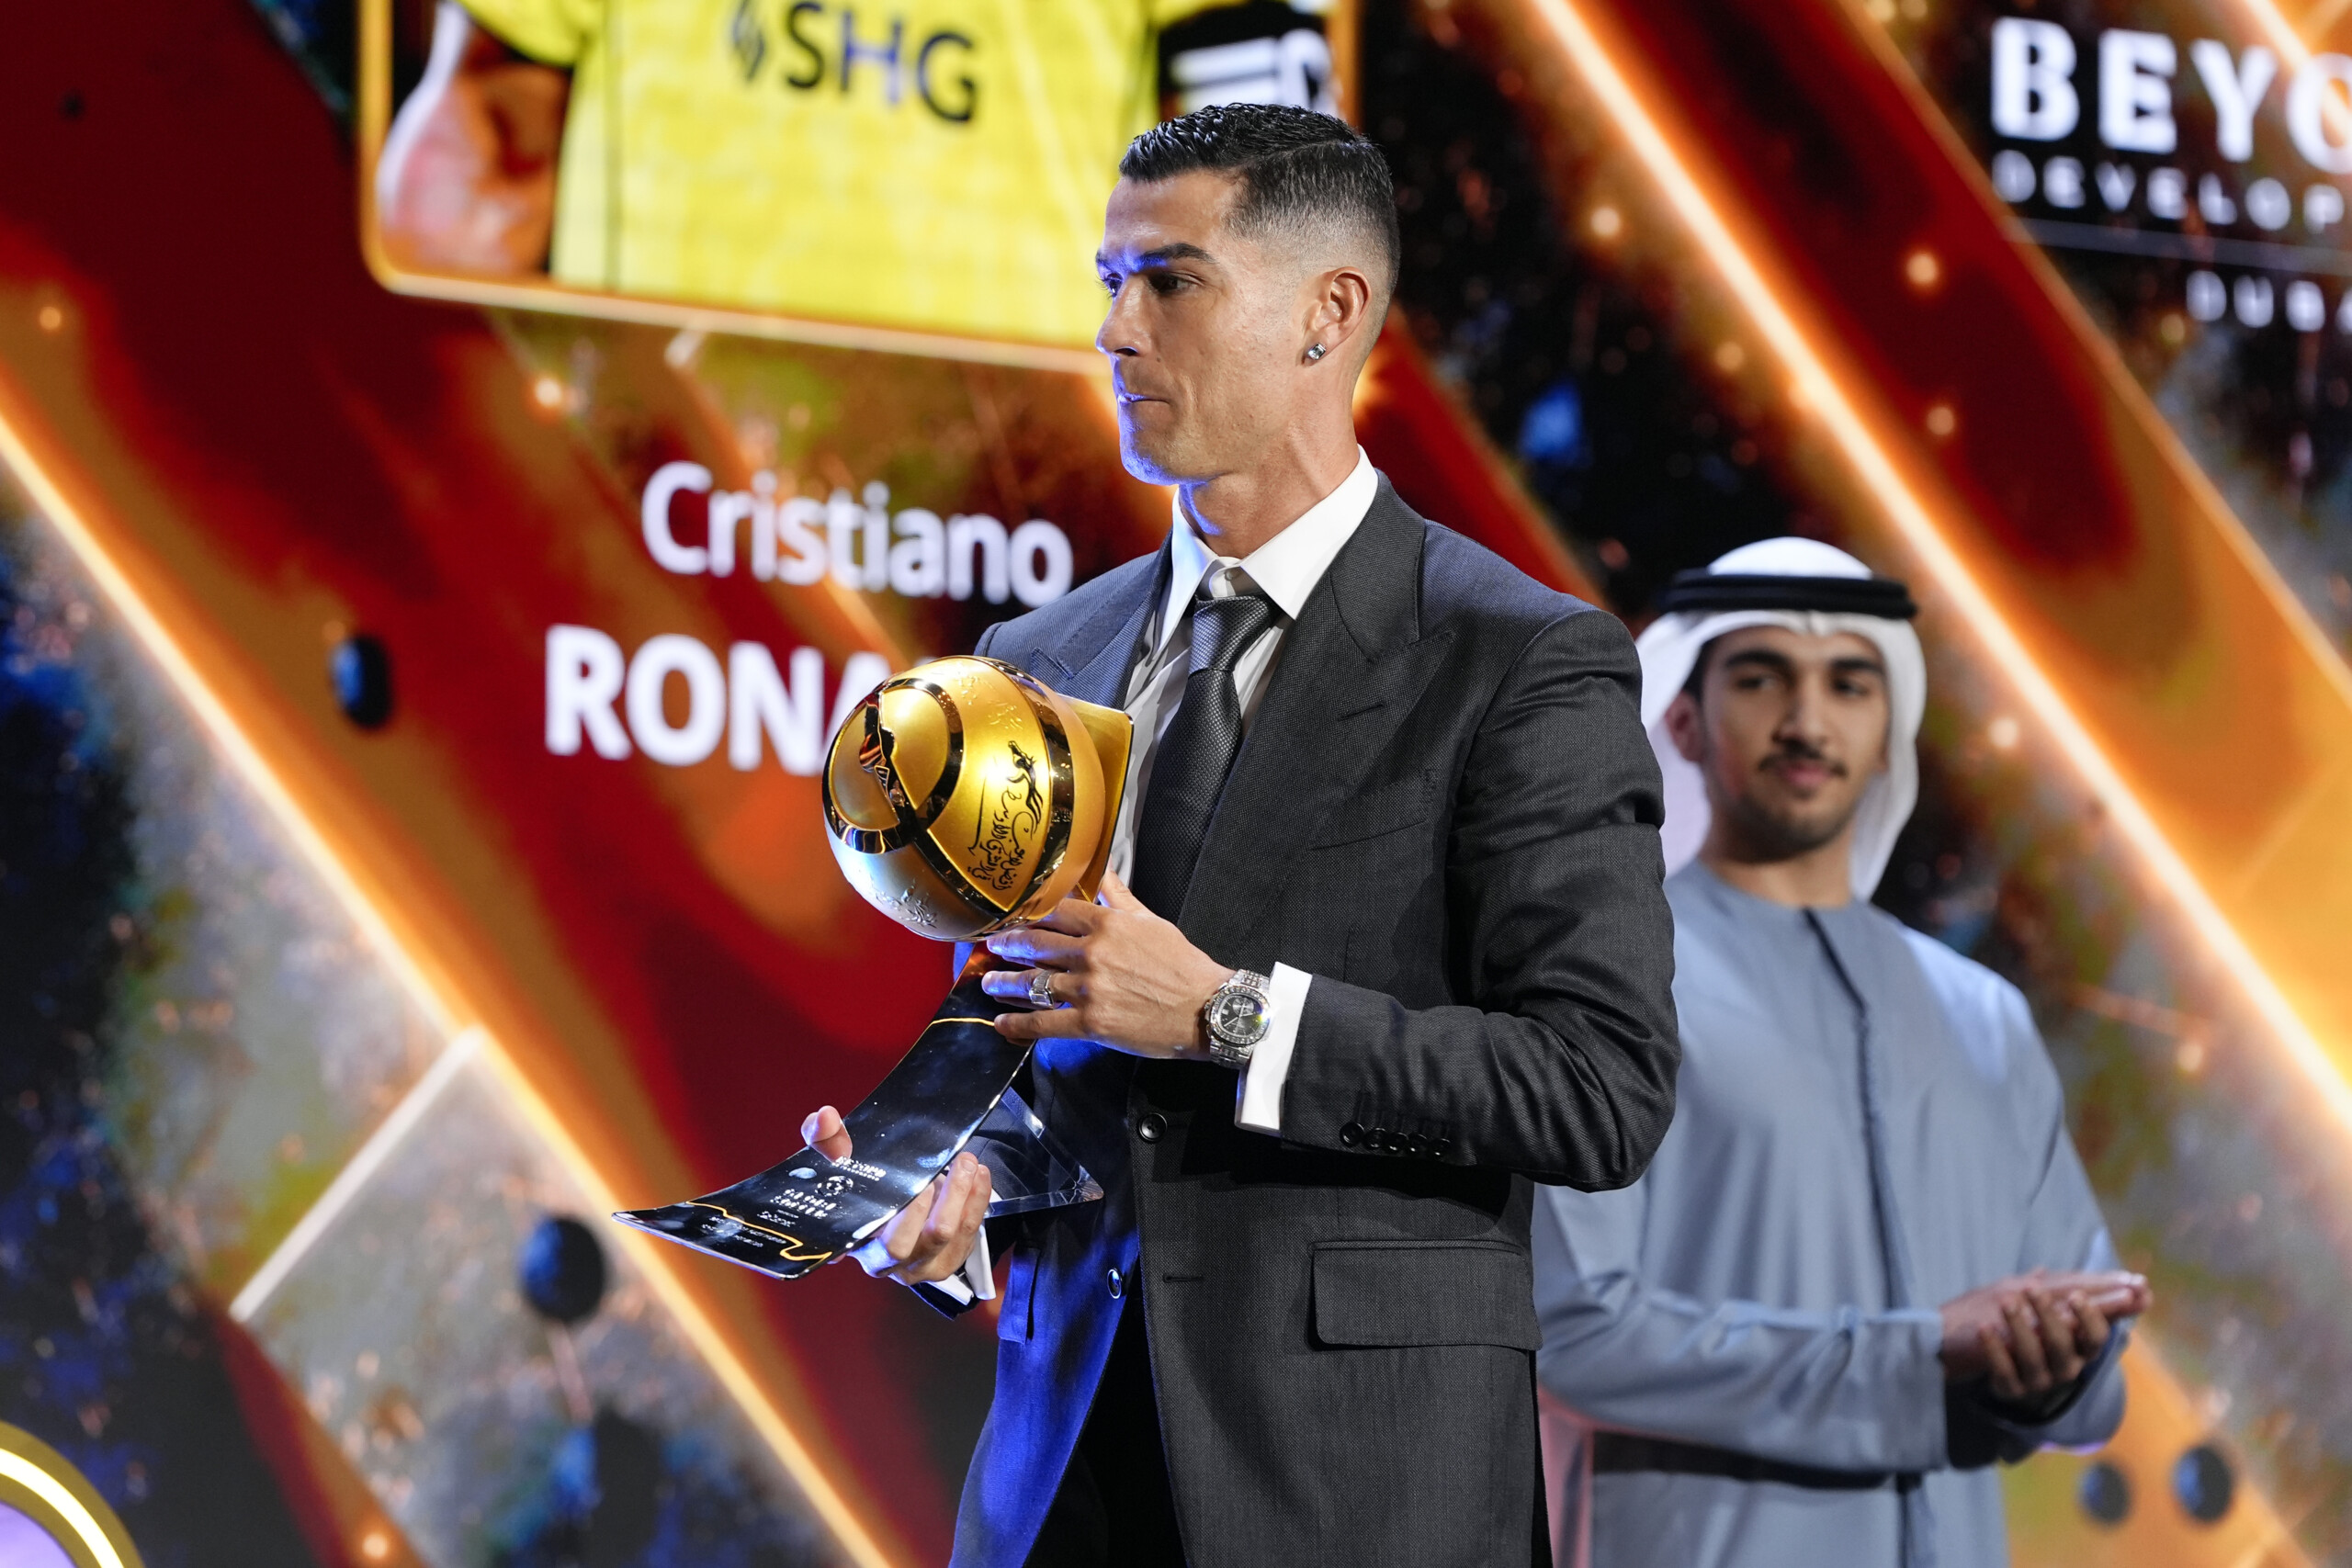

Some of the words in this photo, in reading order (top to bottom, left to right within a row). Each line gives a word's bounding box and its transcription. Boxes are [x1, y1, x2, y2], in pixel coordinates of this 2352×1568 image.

[785, 0, 977, 123] SHG
[1991, 17, 2352, 175] BEYO
[1992, 150, 2346, 233] DEVELOP
[640, 460, 1073, 608] Cristiano
